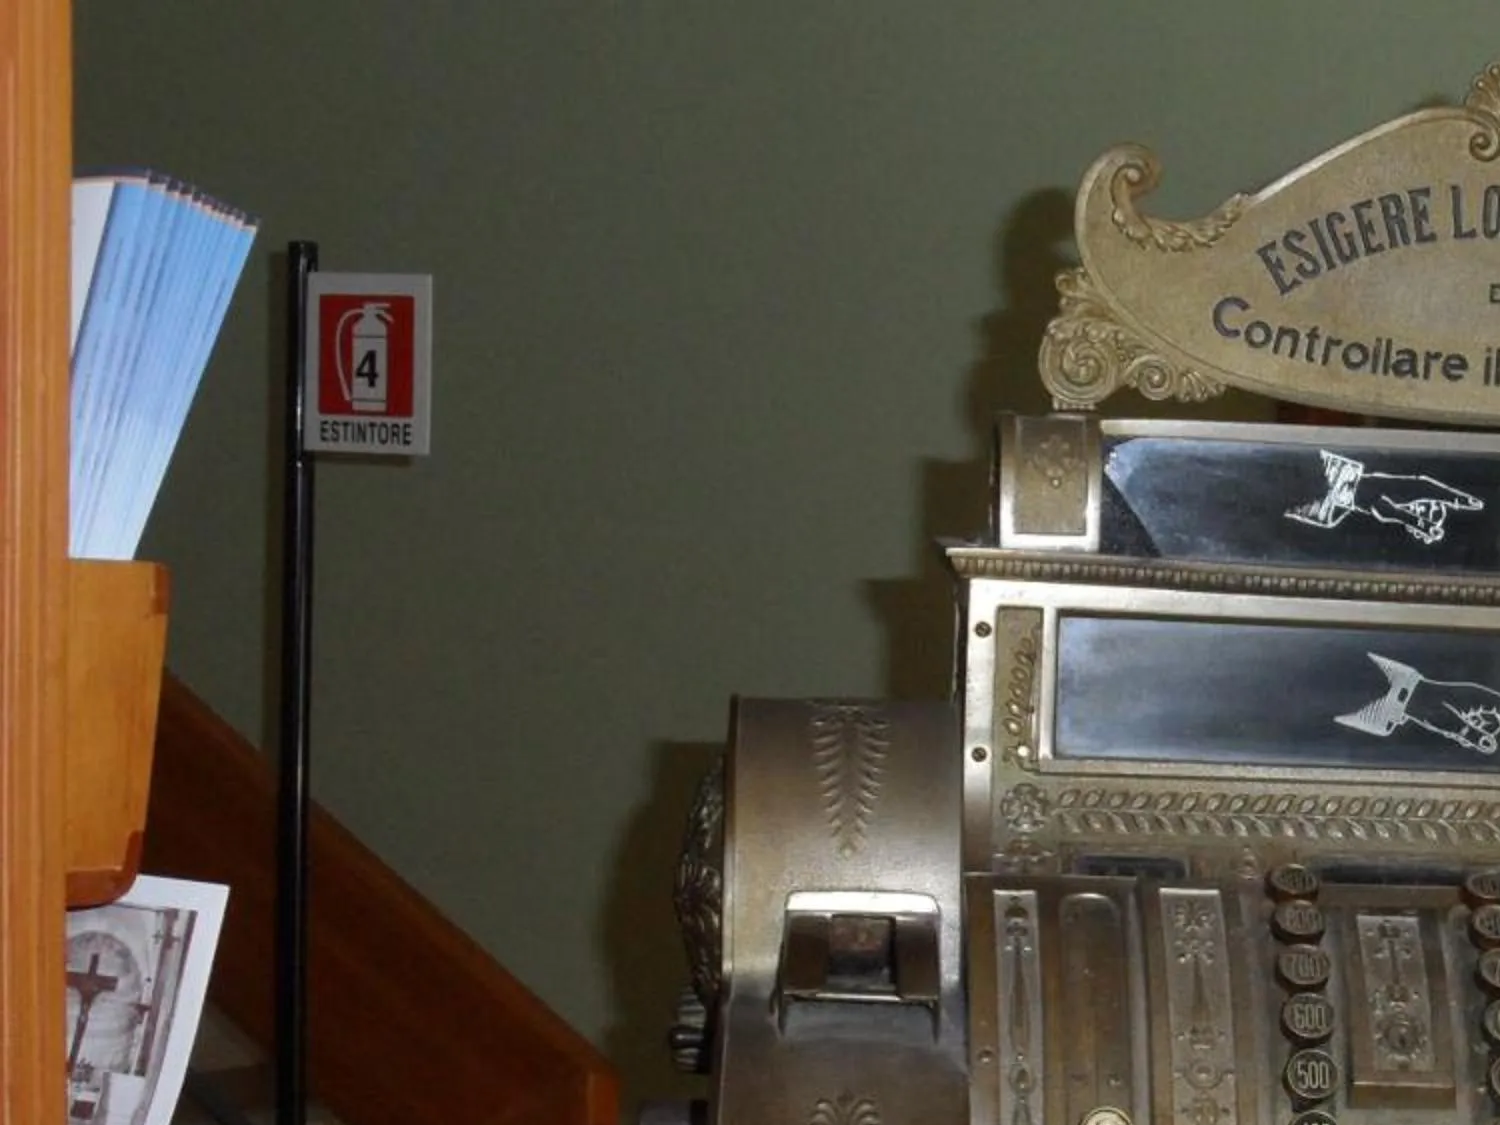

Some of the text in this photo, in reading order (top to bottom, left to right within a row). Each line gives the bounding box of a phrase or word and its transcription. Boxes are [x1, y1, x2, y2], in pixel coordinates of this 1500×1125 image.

[1256, 185, 1438, 296] ESIGERE
[355, 348, 379, 388] 4
[318, 419, 413, 446] ESTINTORE
[1293, 1003, 1326, 1034] 600
[1296, 1060, 1329, 1090] 500
